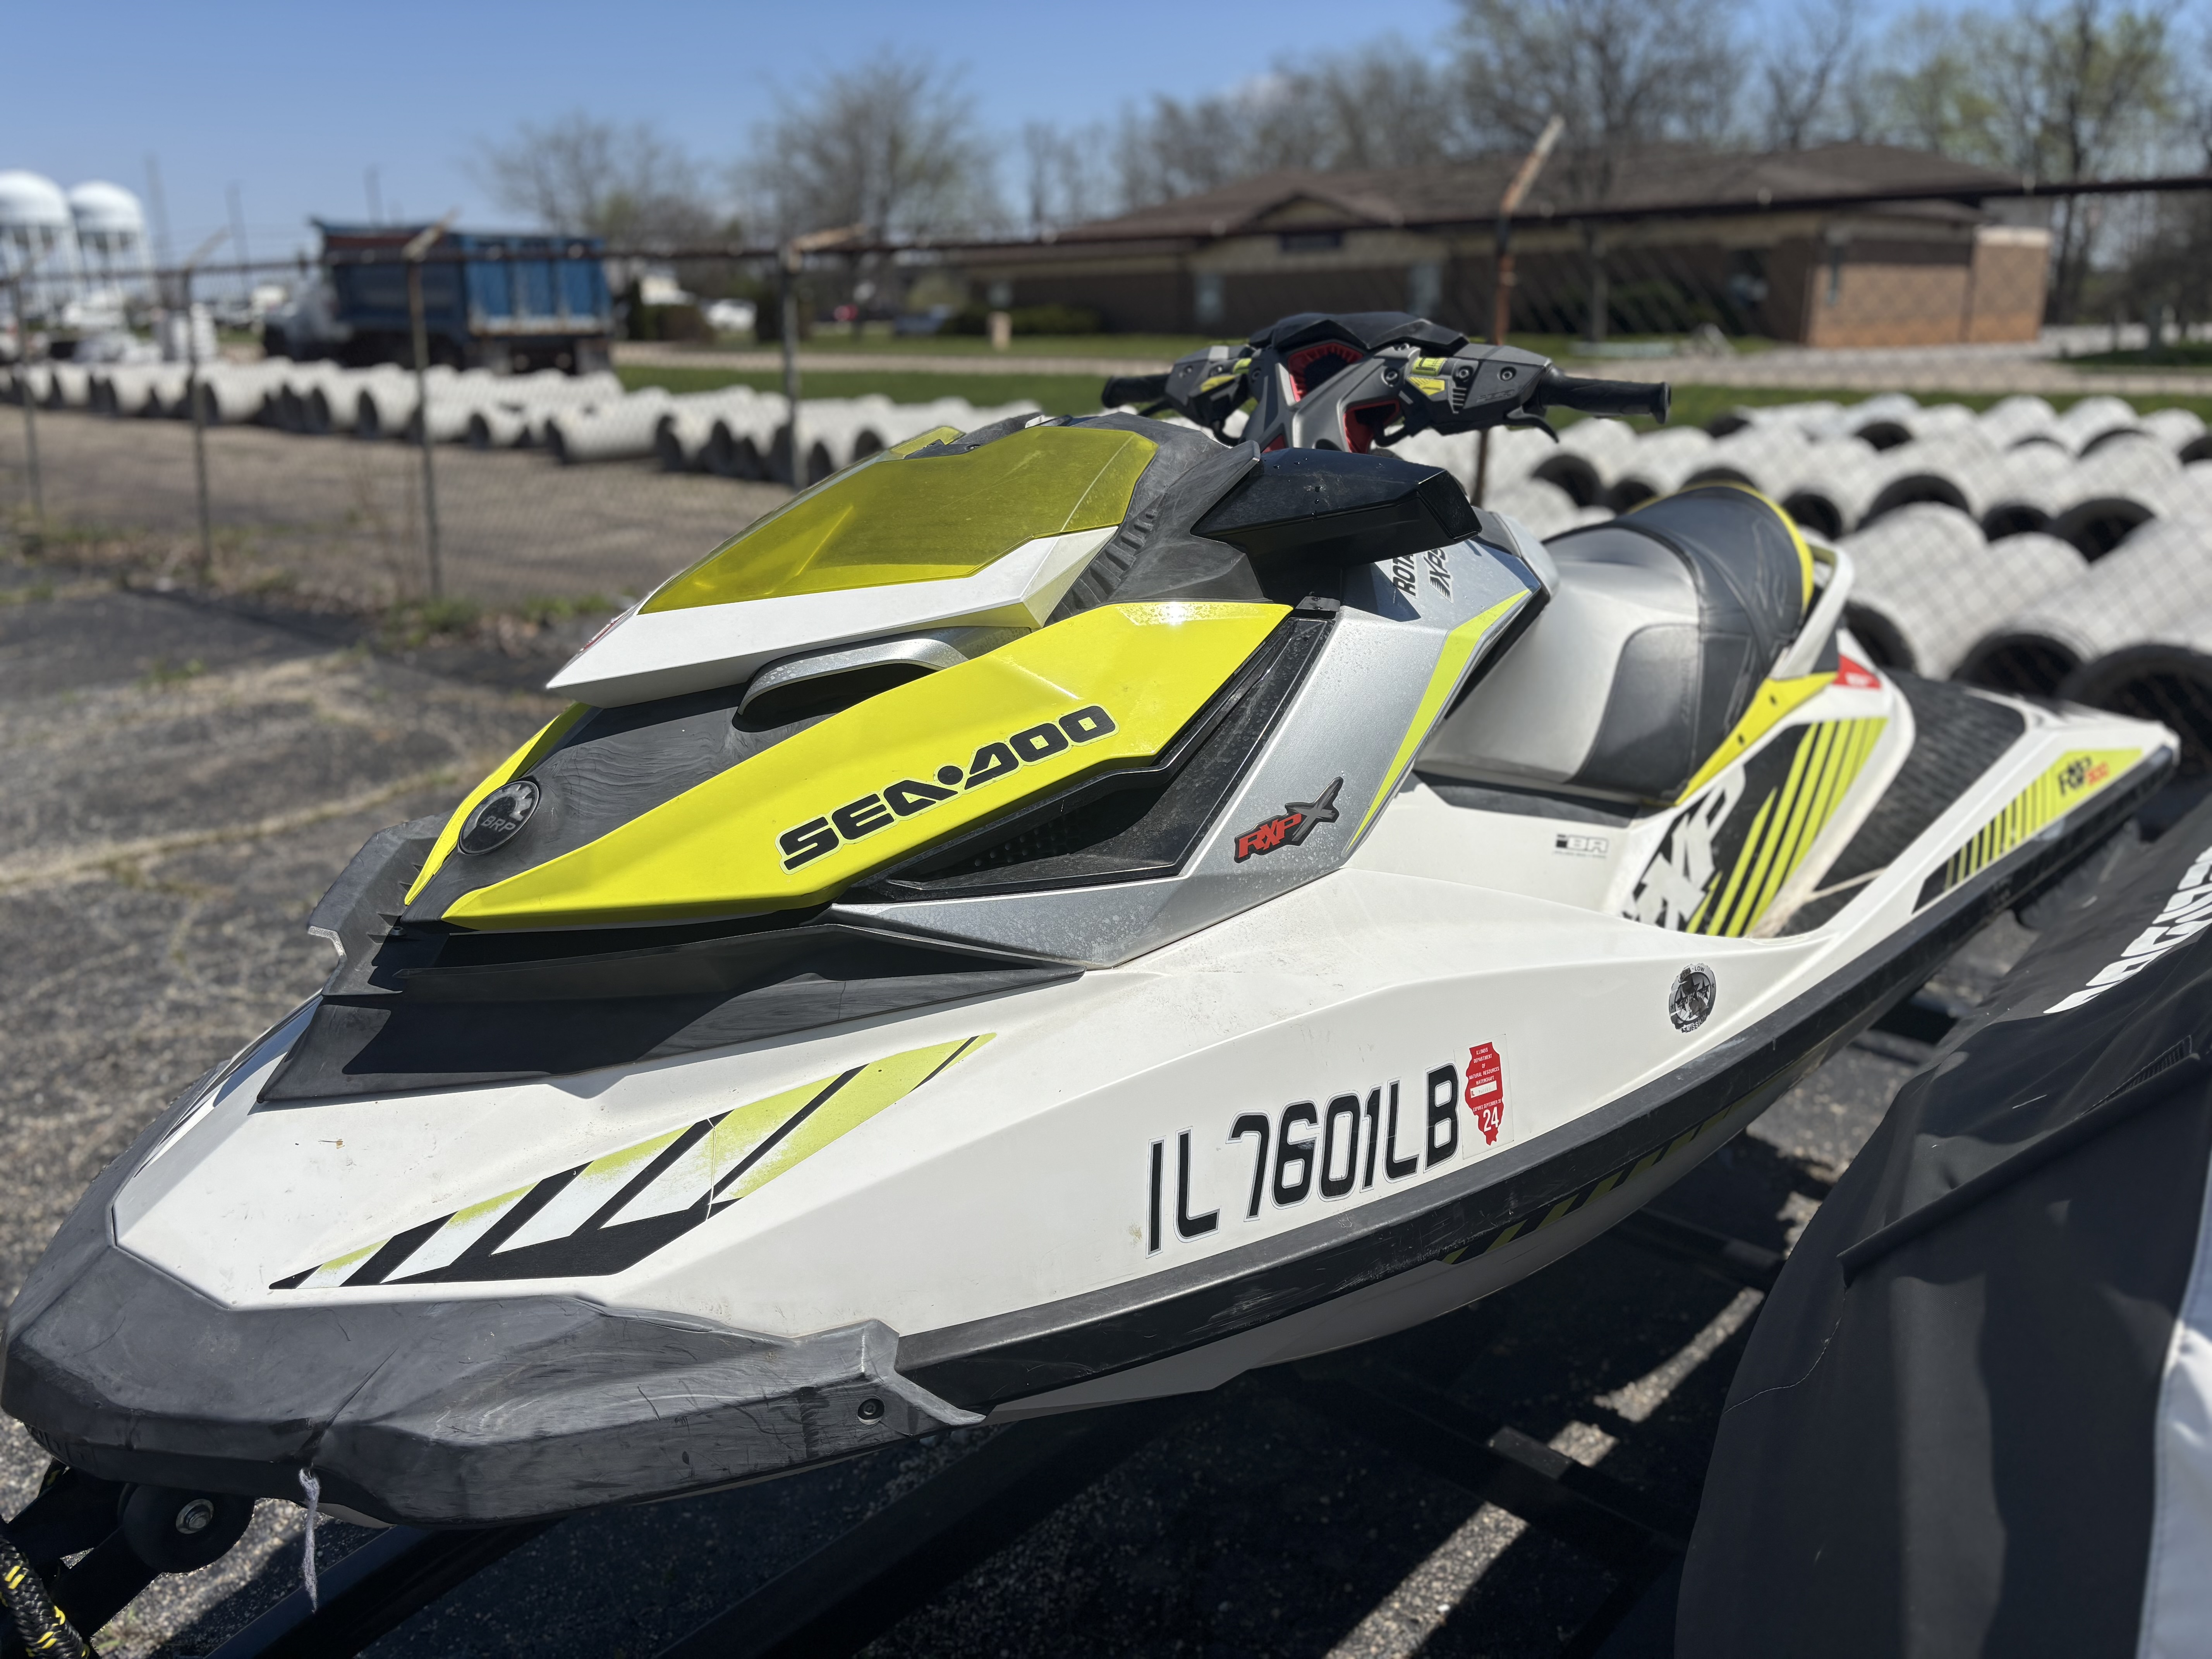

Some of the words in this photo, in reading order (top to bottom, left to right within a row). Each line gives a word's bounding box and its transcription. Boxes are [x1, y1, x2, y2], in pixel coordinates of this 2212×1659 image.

[481, 815, 516, 832] BRP
[1474, 1053, 1492, 1063] DEPARTMENT
[1483, 1066, 1499, 1075] RESOURCES
[1476, 1075, 1494, 1085] WATERCRAFT
[1484, 1100, 1498, 1109] SEPTEMBER
[1483, 1106, 1499, 1132] 24
[1148, 1128, 1219, 1255] IL
